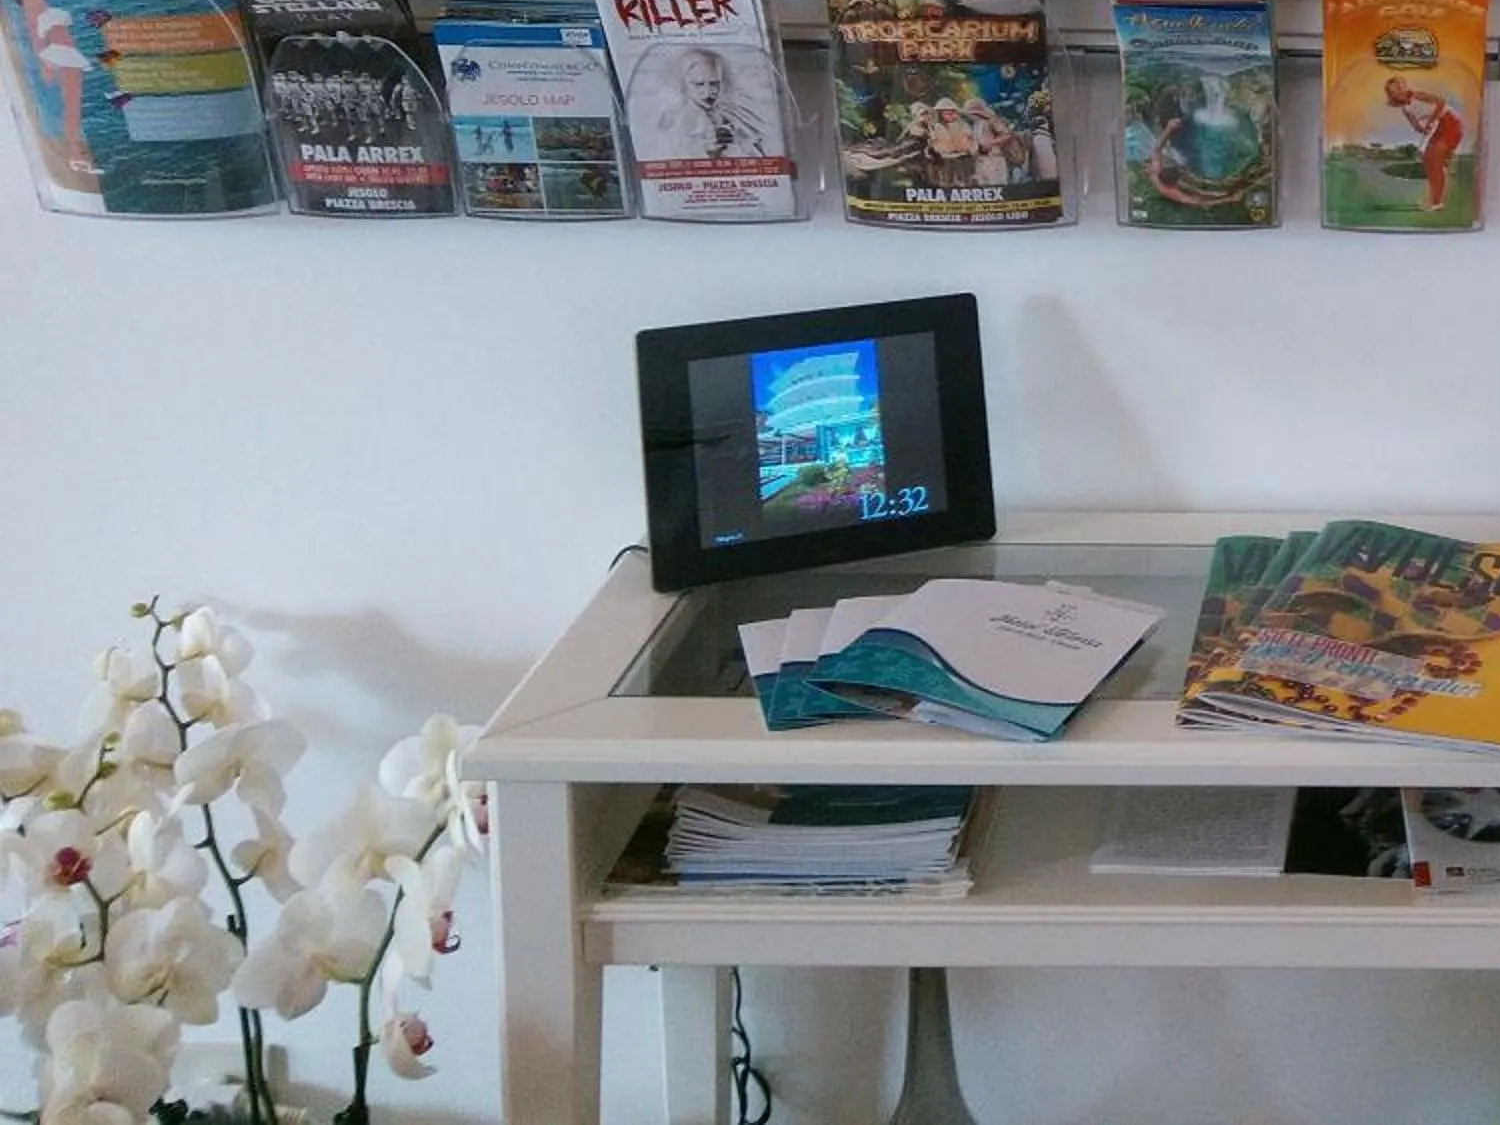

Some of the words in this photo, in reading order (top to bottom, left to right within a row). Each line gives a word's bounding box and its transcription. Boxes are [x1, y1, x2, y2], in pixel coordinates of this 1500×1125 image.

[838, 20, 1040, 43] TROPICARIUM
[899, 39, 976, 62] PARK
[301, 144, 352, 163] PALA
[357, 146, 425, 164] ARREX
[905, 188, 946, 202] PALA
[951, 187, 1004, 201] ARREX
[859, 486, 929, 520] 12:32
